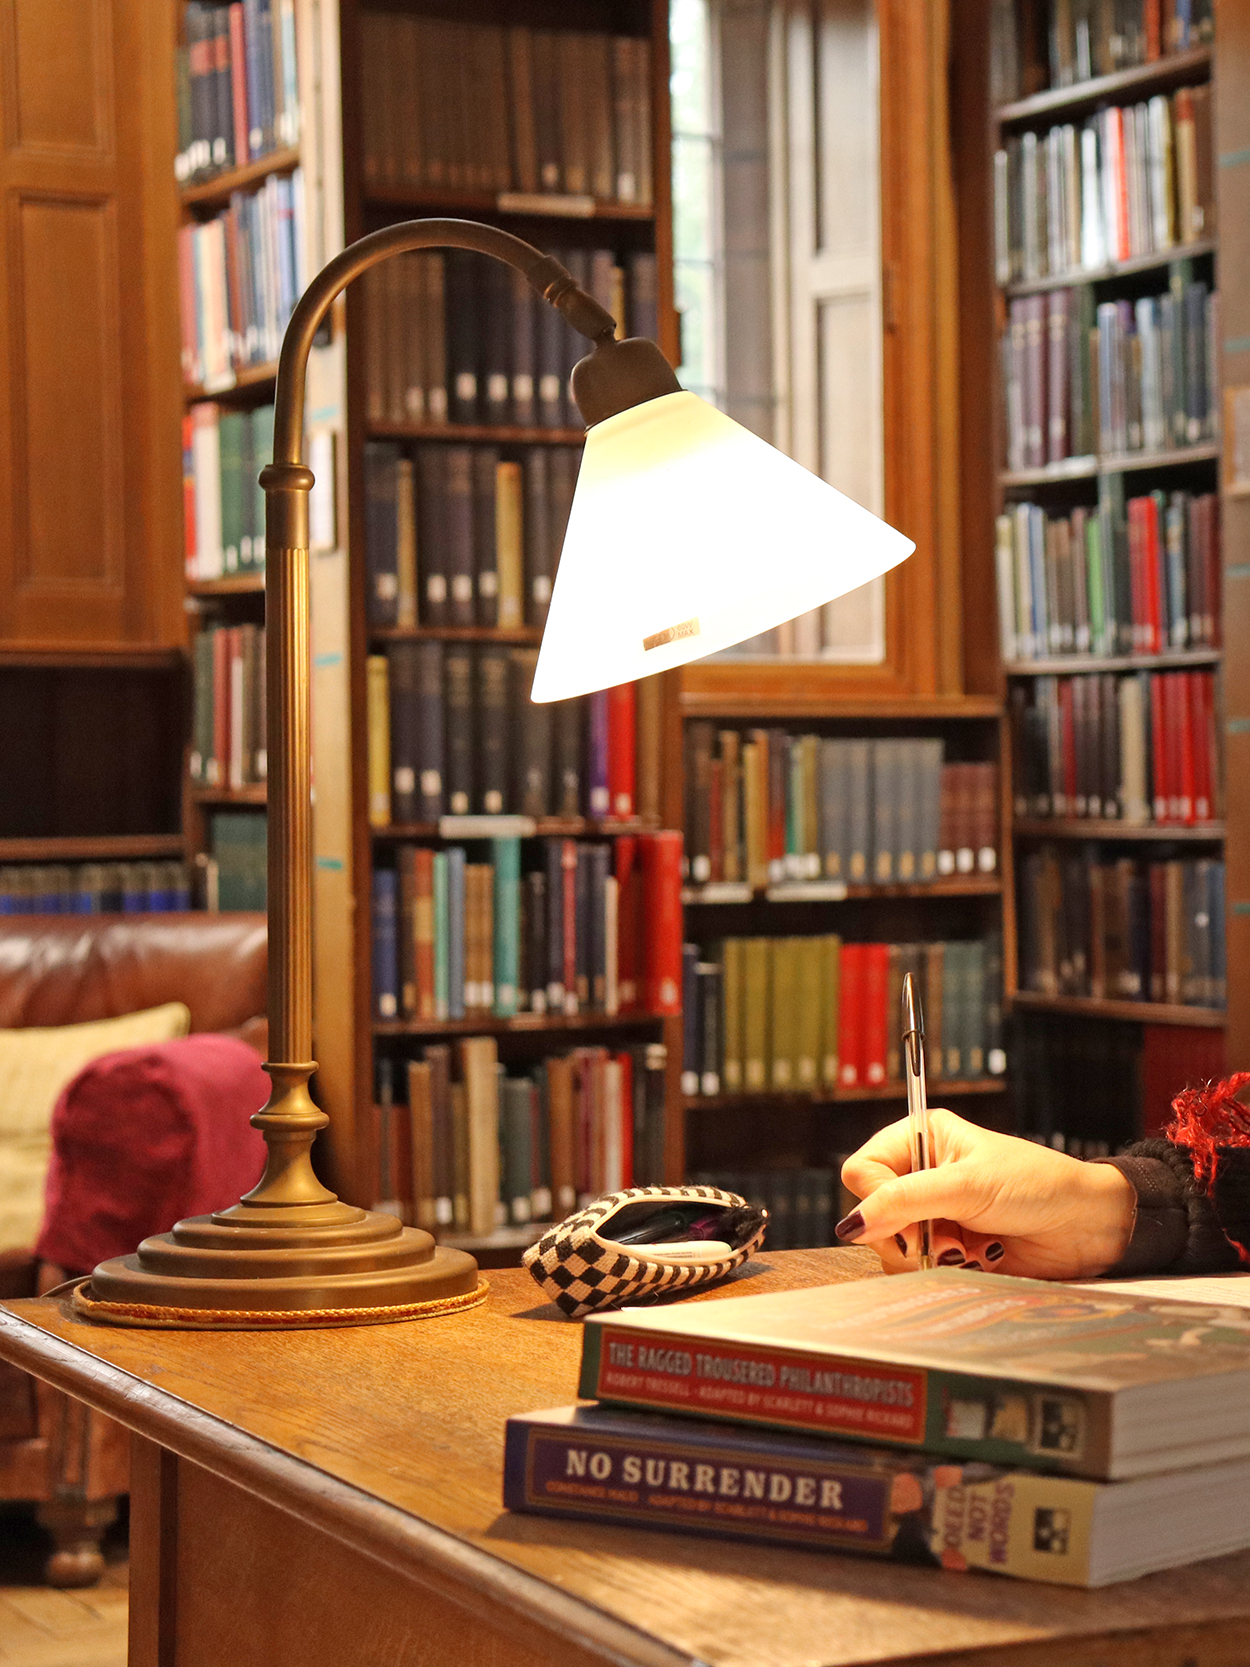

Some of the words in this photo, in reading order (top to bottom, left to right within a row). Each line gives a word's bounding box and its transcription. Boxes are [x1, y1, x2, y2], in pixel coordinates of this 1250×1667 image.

[677, 628, 694, 638] MAX
[609, 1342, 634, 1368] THE
[637, 1346, 692, 1376] RAGGED
[696, 1353, 776, 1387] TROUSERED
[779, 1365, 914, 1408] PHILANTHROPISTS
[566, 1449, 613, 1480] NO
[622, 1454, 843, 1511] SURRENDER
[967, 1491, 987, 1541] NOT
[989, 1483, 1015, 1564] WORDS
